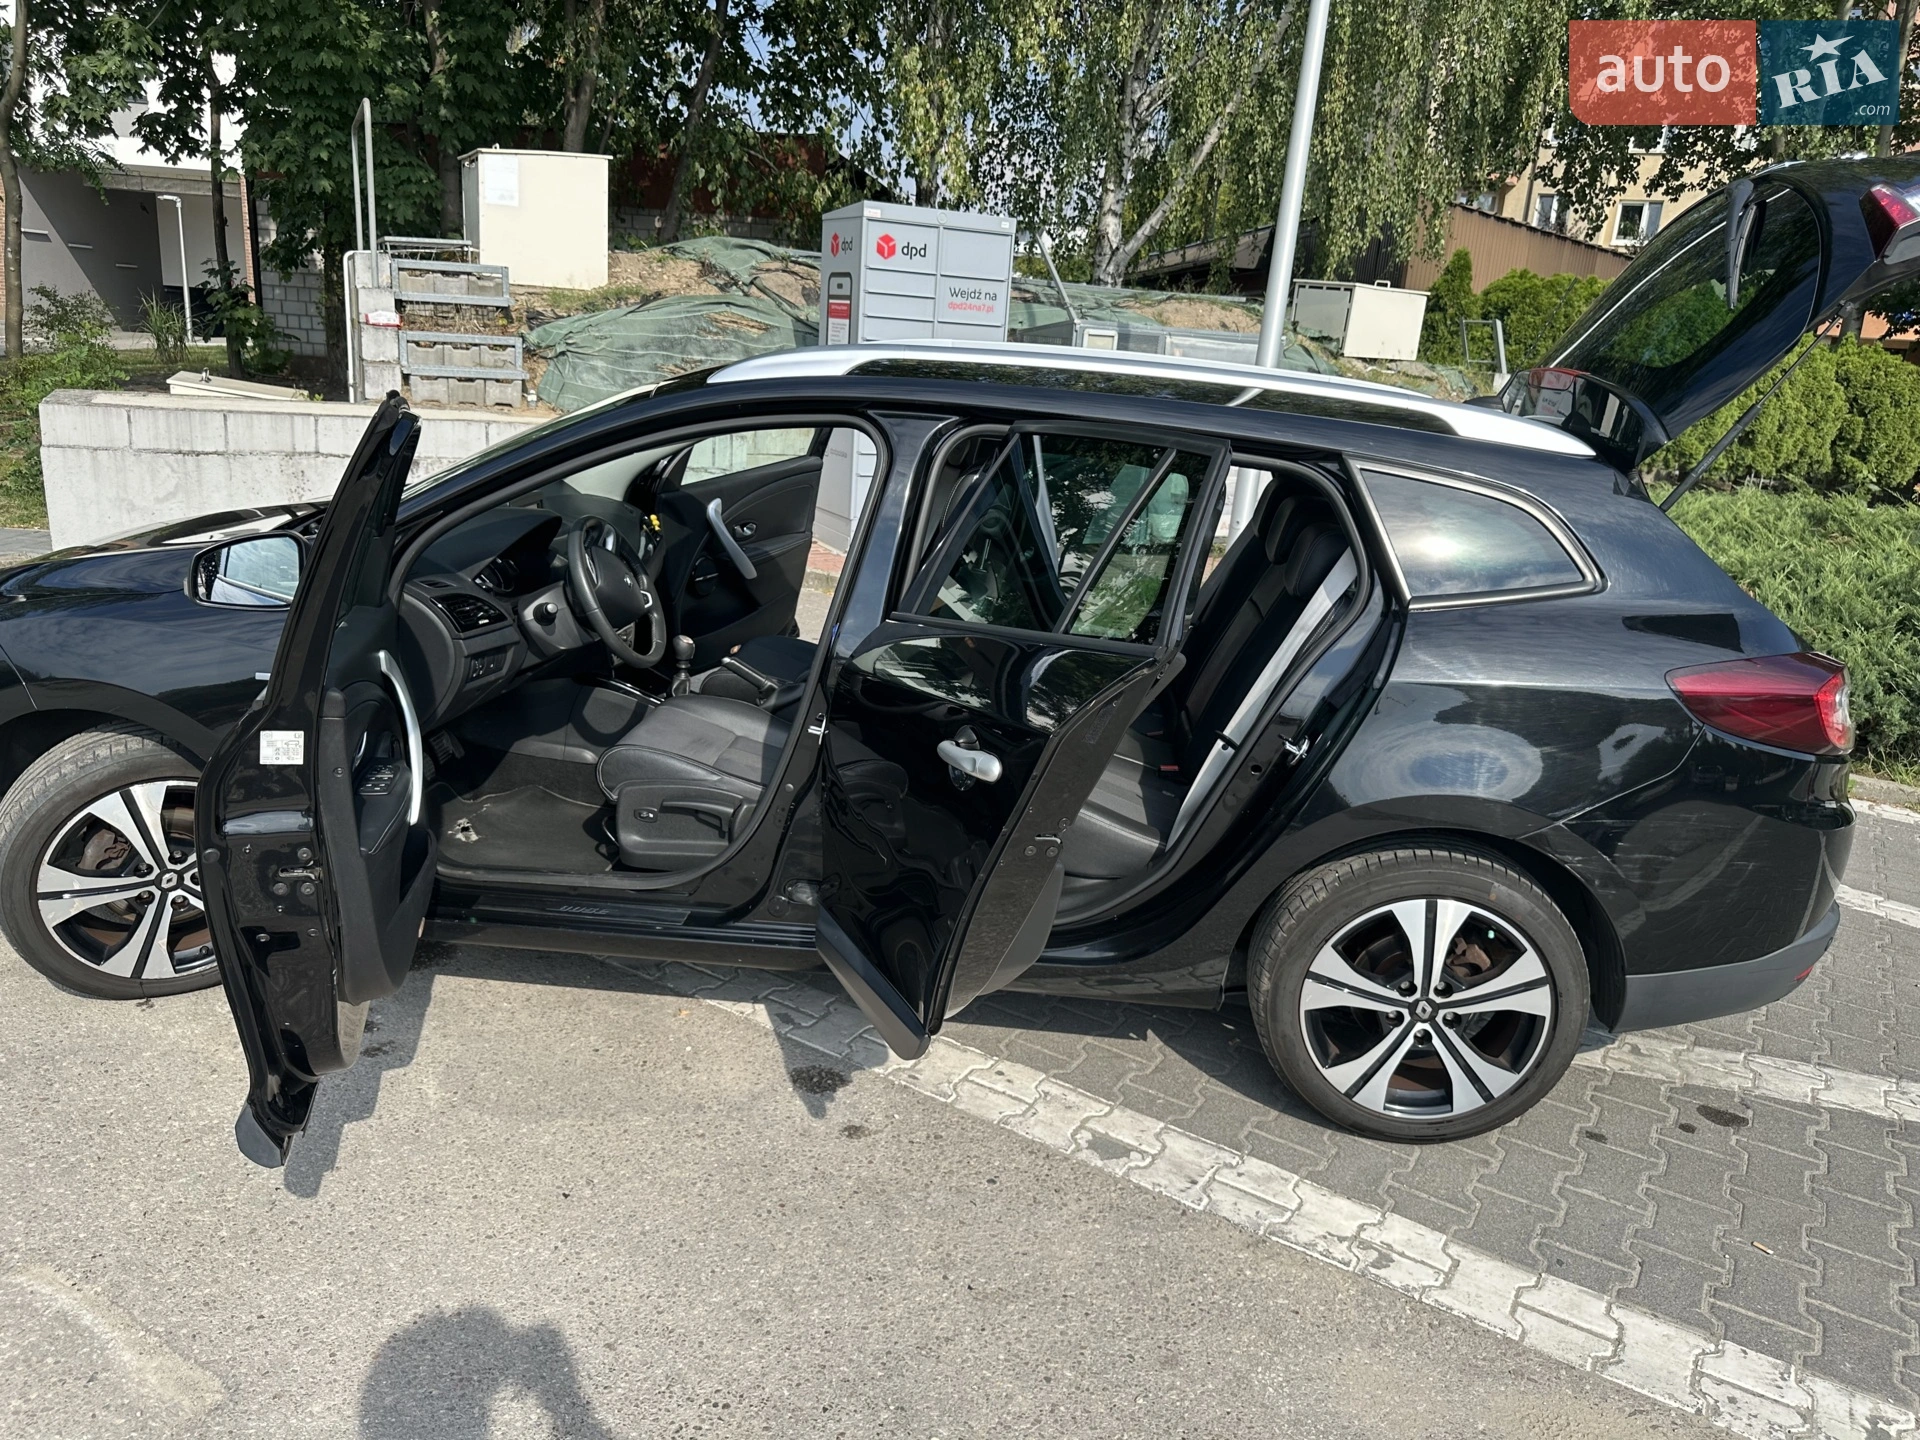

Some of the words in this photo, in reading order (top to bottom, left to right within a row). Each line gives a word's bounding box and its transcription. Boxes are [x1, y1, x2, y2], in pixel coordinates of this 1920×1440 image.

[841, 237, 853, 255] dpd
[902, 242, 927, 260] dpd
[949, 287, 982, 302] Wejdź
[984, 293, 997, 301] na
[948, 302, 994, 313] dpd24na7.pl
